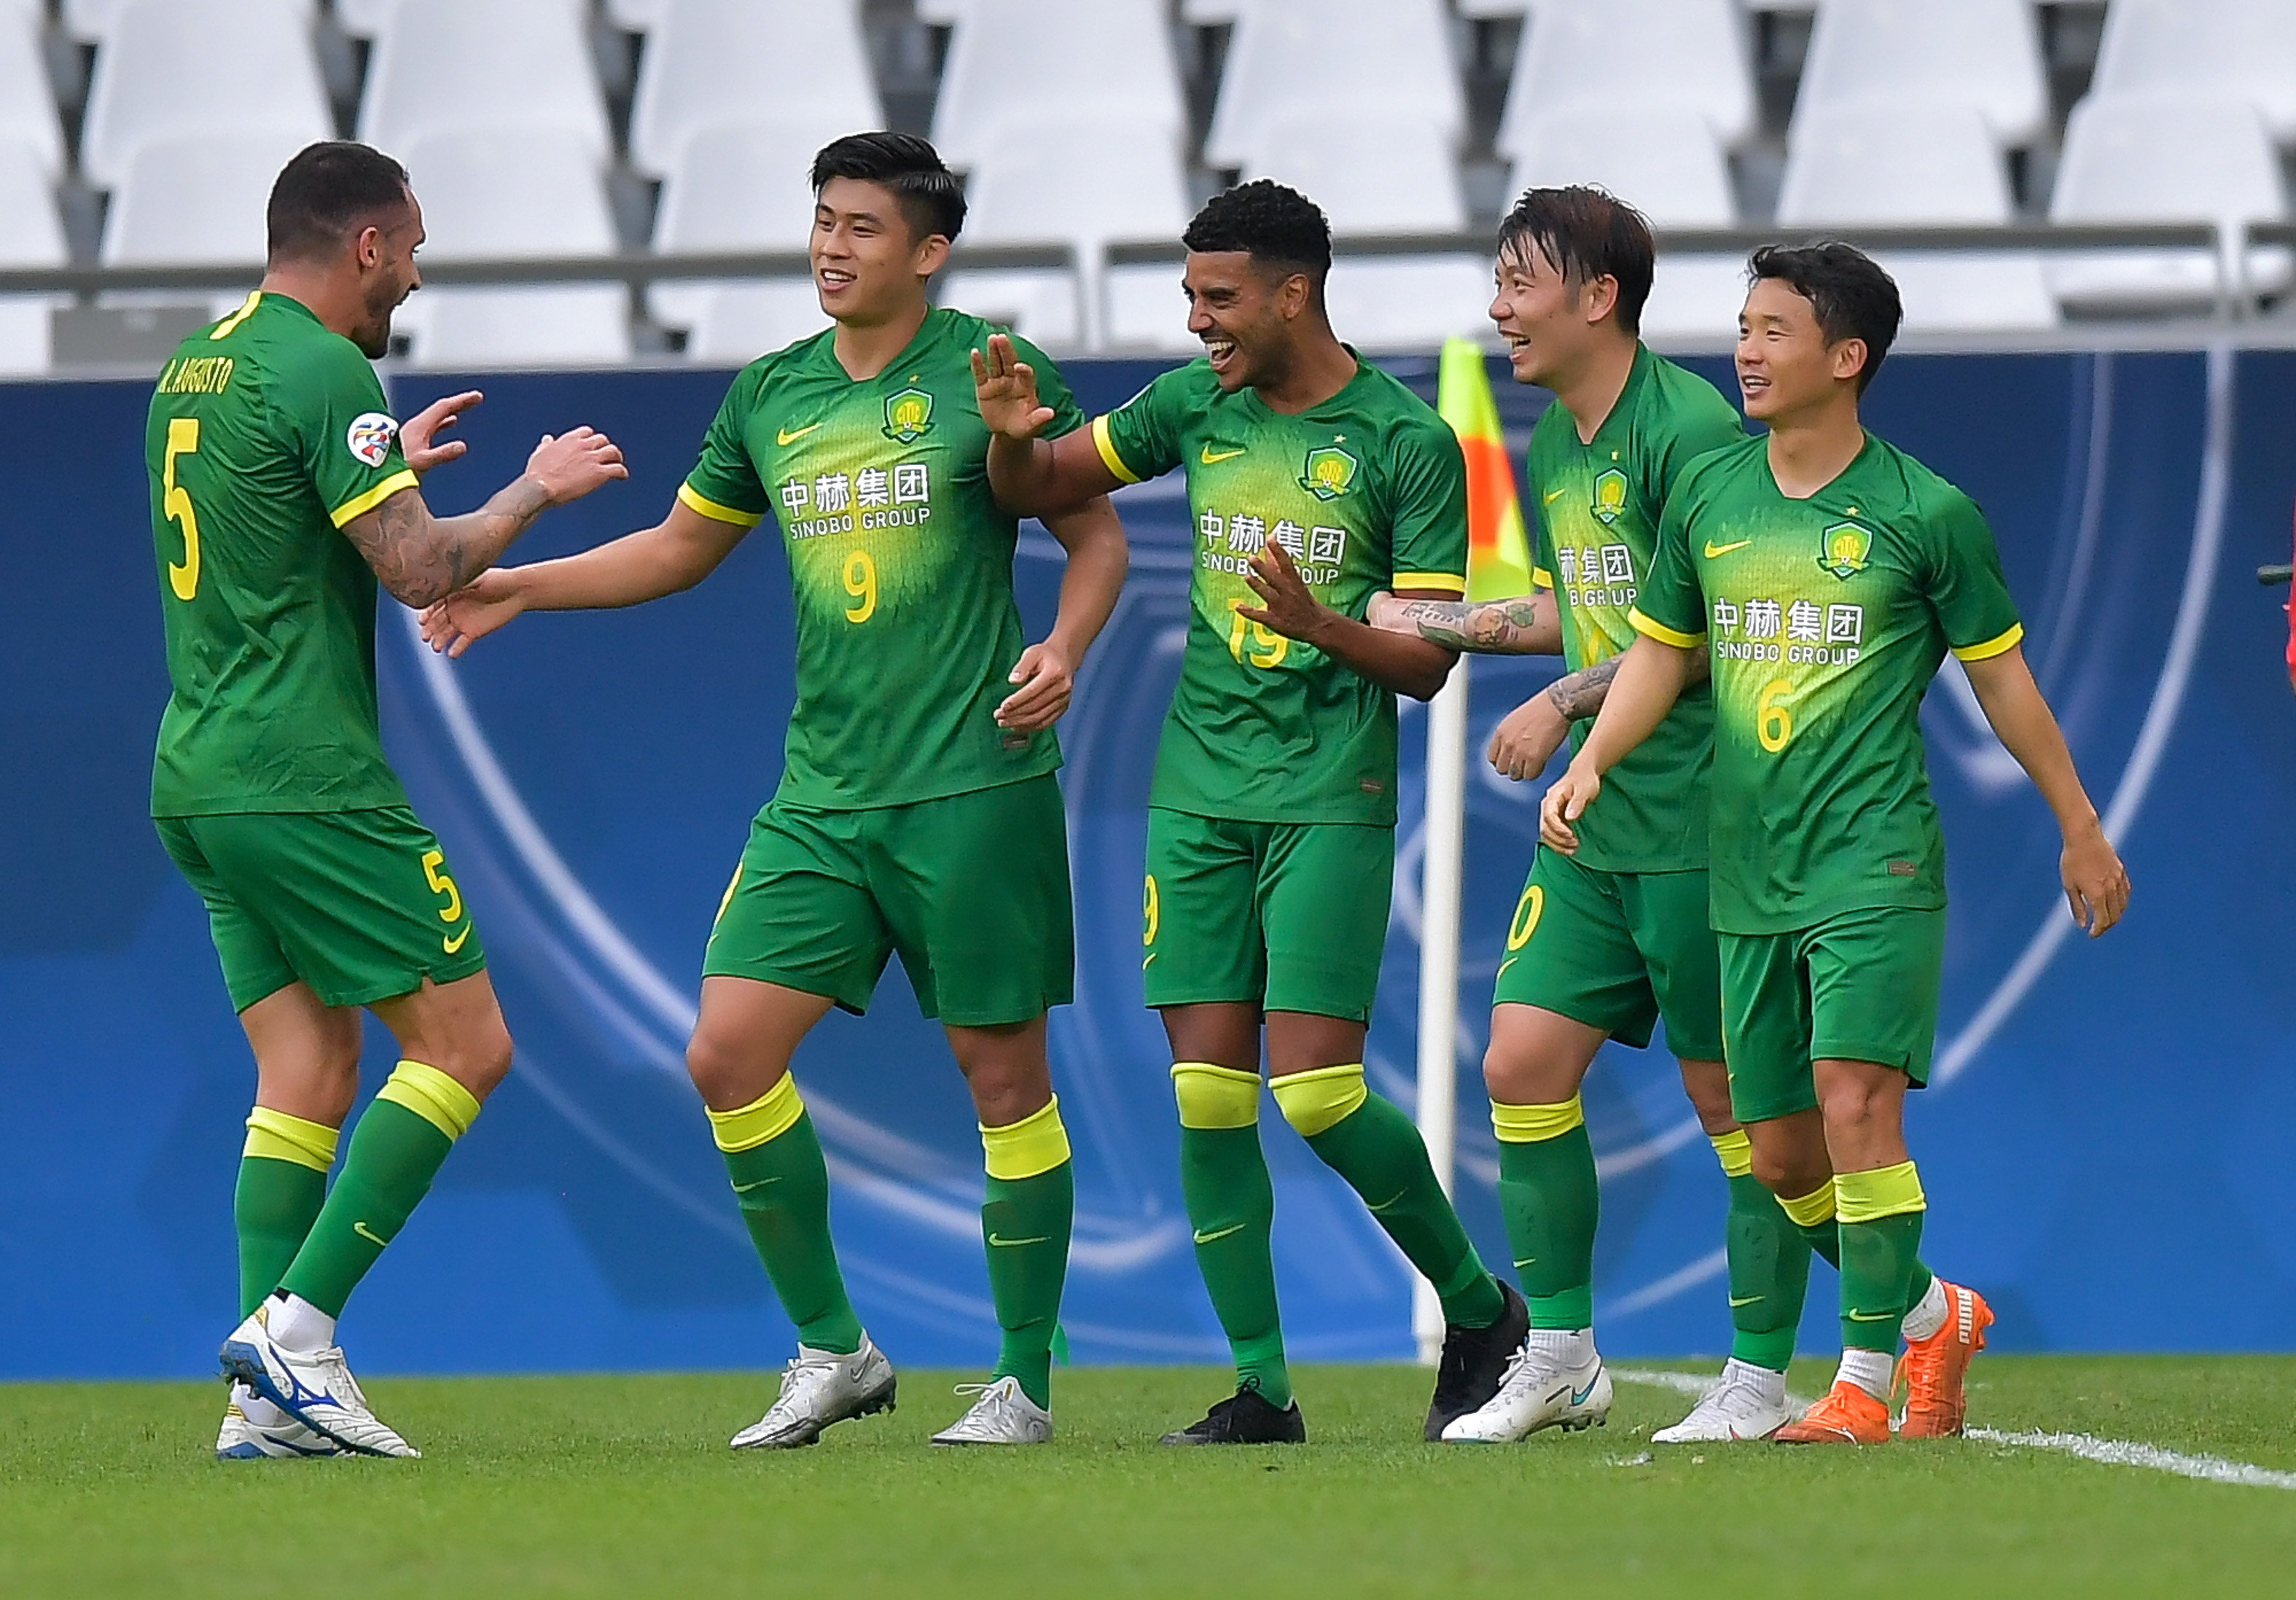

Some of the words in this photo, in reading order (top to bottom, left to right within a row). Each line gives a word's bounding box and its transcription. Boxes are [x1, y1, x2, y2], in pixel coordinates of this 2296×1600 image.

[164, 418, 200, 601] 5
[781, 464, 929, 518] 中赫集团
[789, 515, 853, 539] SINOBO
[862, 507, 930, 530] GROUP
[1200, 508, 1346, 565] 中赫集团
[843, 550, 877, 623] 9
[1201, 551, 1260, 577] SNOB
[1294, 565, 1339, 585] OUP
[1584, 588, 1637, 606] GRUP
[1714, 597, 1863, 644] 中赫集团
[1788, 646, 1859, 666] GROUP
[1757, 679, 1793, 753] 6
[422, 850, 461, 922] 5
